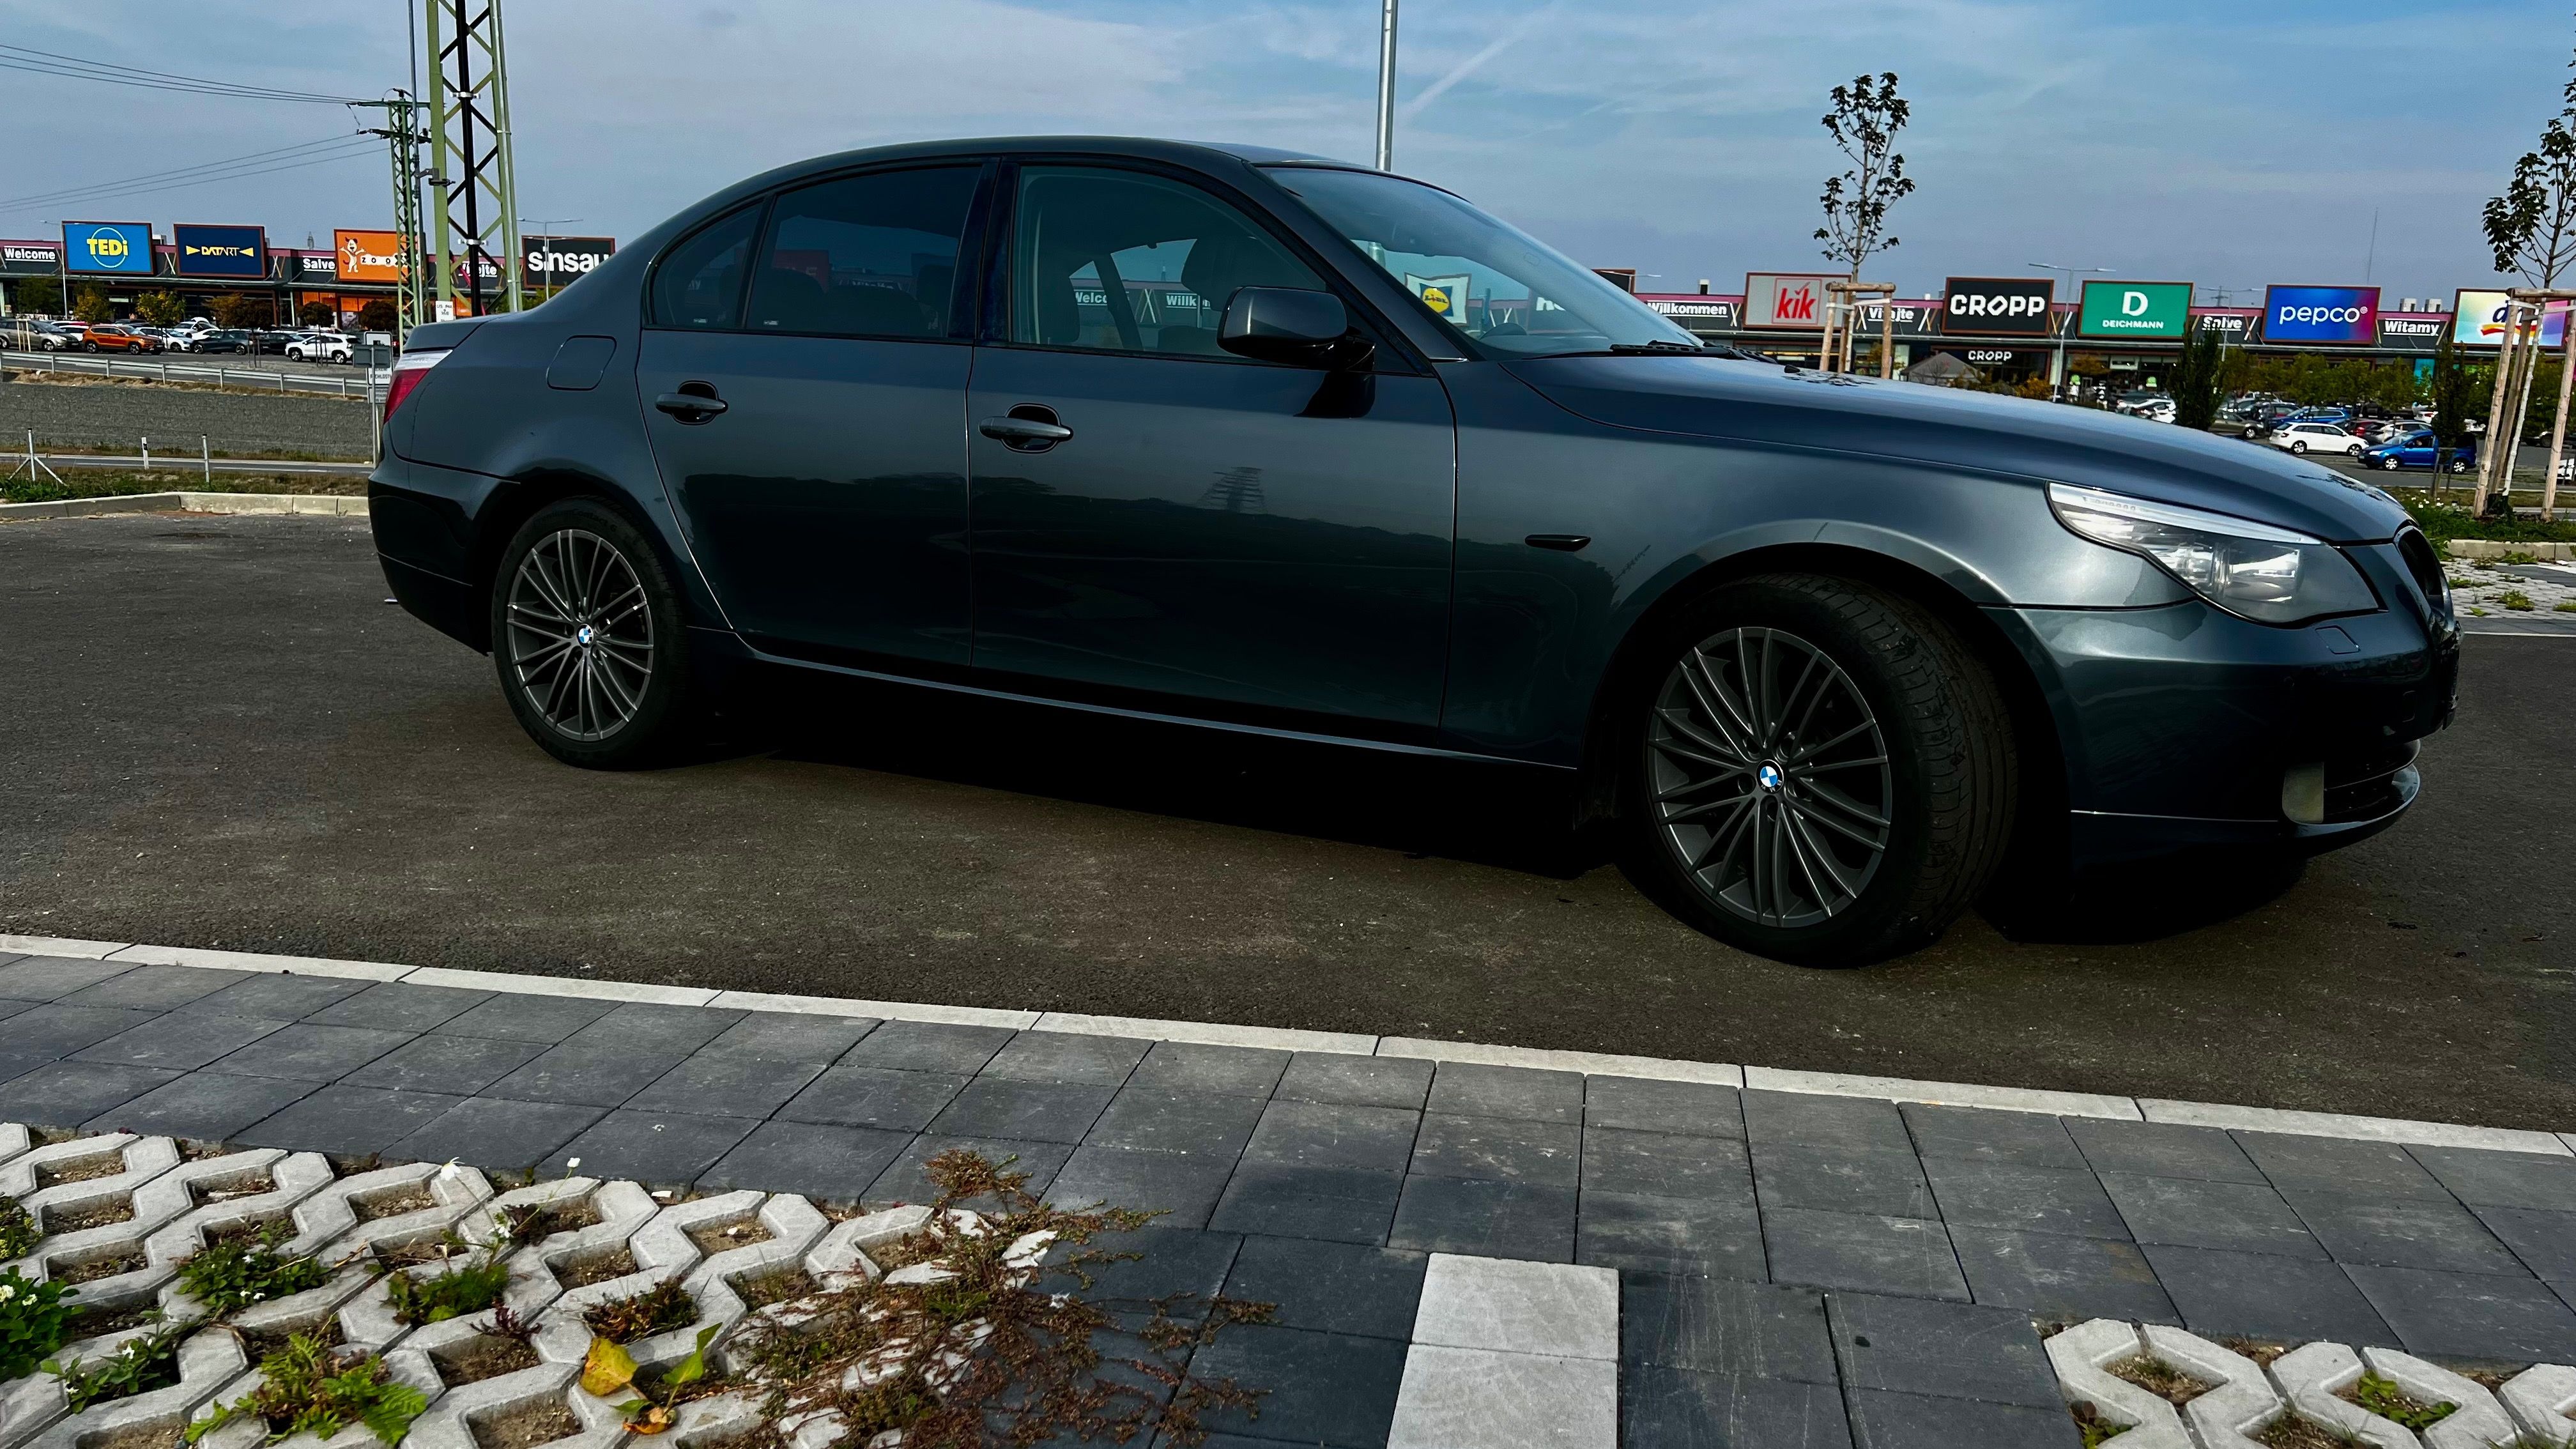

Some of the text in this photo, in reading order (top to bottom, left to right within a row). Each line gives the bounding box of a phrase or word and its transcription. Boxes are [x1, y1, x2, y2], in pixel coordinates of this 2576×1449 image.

[86, 238, 128, 256] TEDi
[201, 246, 240, 256] DATART
[4, 248, 56, 260] Welcome
[303, 257, 335, 270] Salve
[1075, 292, 1107, 303] Welco
[1776, 283, 1816, 319] kik
[2122, 291, 2149, 316] D
[1647, 302, 1727, 315] Willkommen
[1950, 294, 2045, 317] CROPP
[1869, 307, 1914, 322] Viajte
[2102, 319, 2165, 329] DEICHMANN
[2202, 316, 2242, 329] Salve
[2384, 320, 2440, 337] Witamy
[1968, 350, 2012, 362] CROPP
